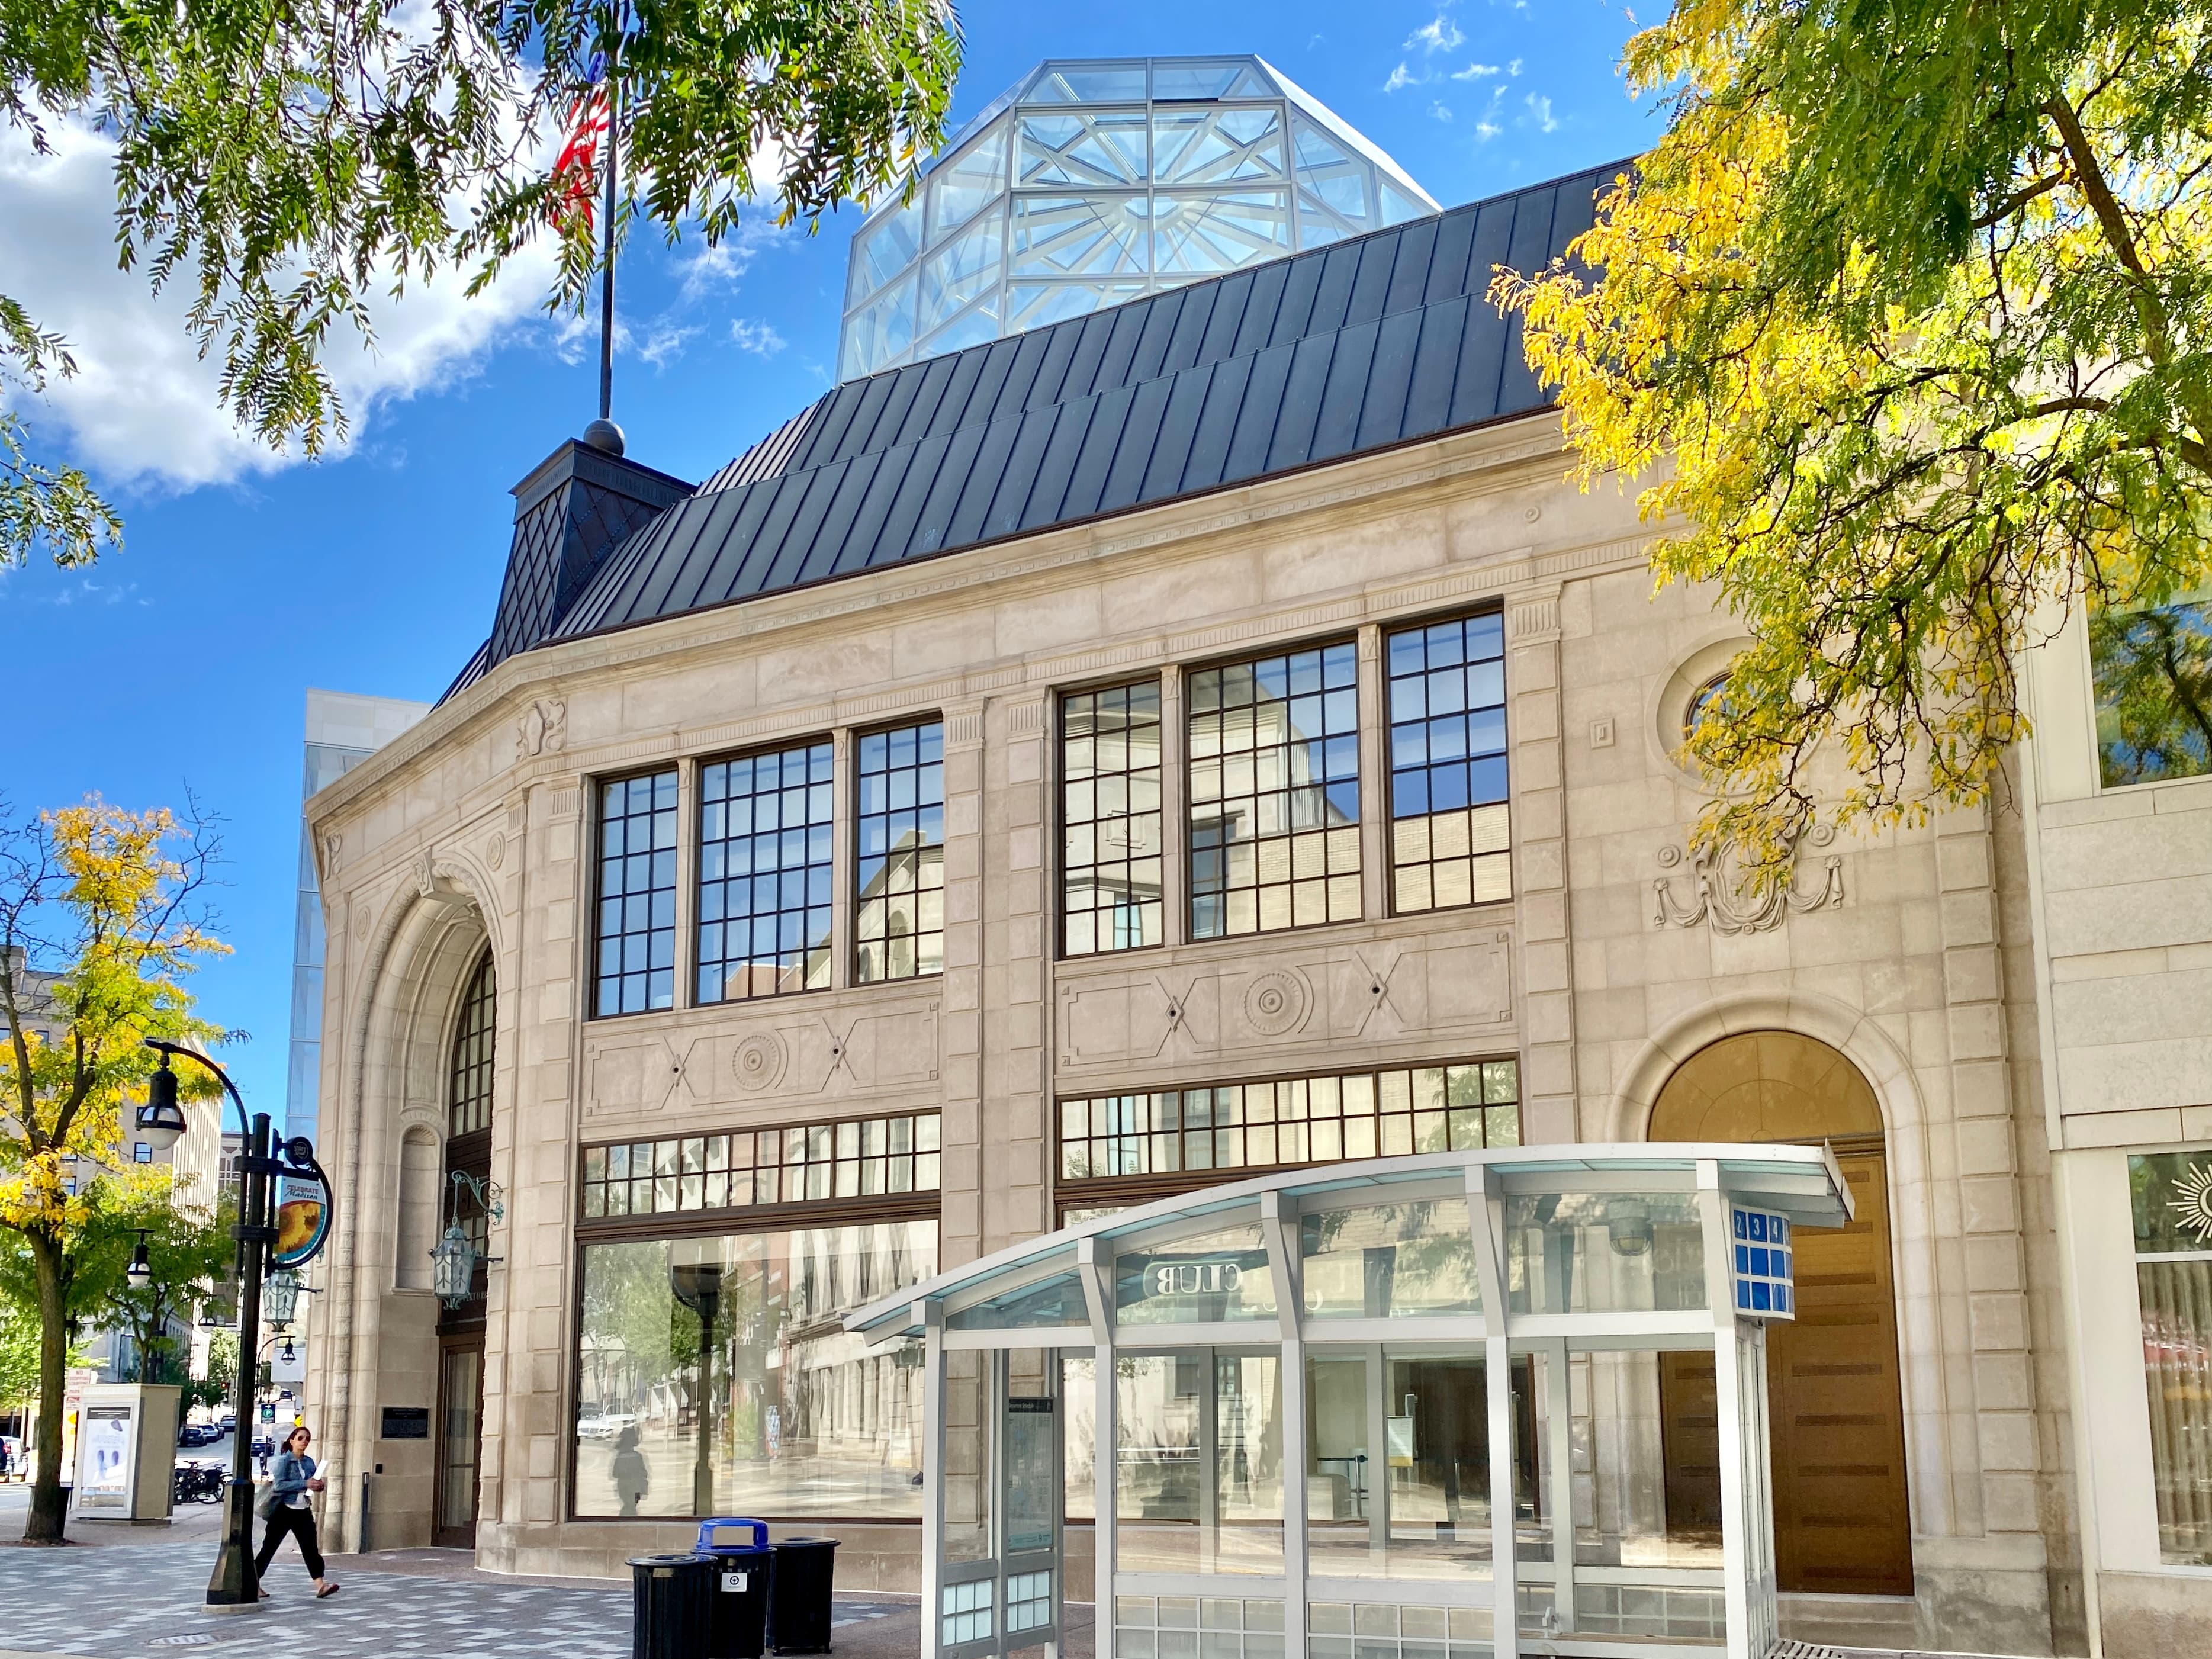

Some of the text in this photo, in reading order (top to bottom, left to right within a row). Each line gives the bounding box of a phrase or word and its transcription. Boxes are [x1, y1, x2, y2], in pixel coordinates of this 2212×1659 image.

[285, 1188, 318, 1200] Madison
[287, 1185, 319, 1194] CELEBRATE
[1737, 1216, 1777, 1238] 2 3 4
